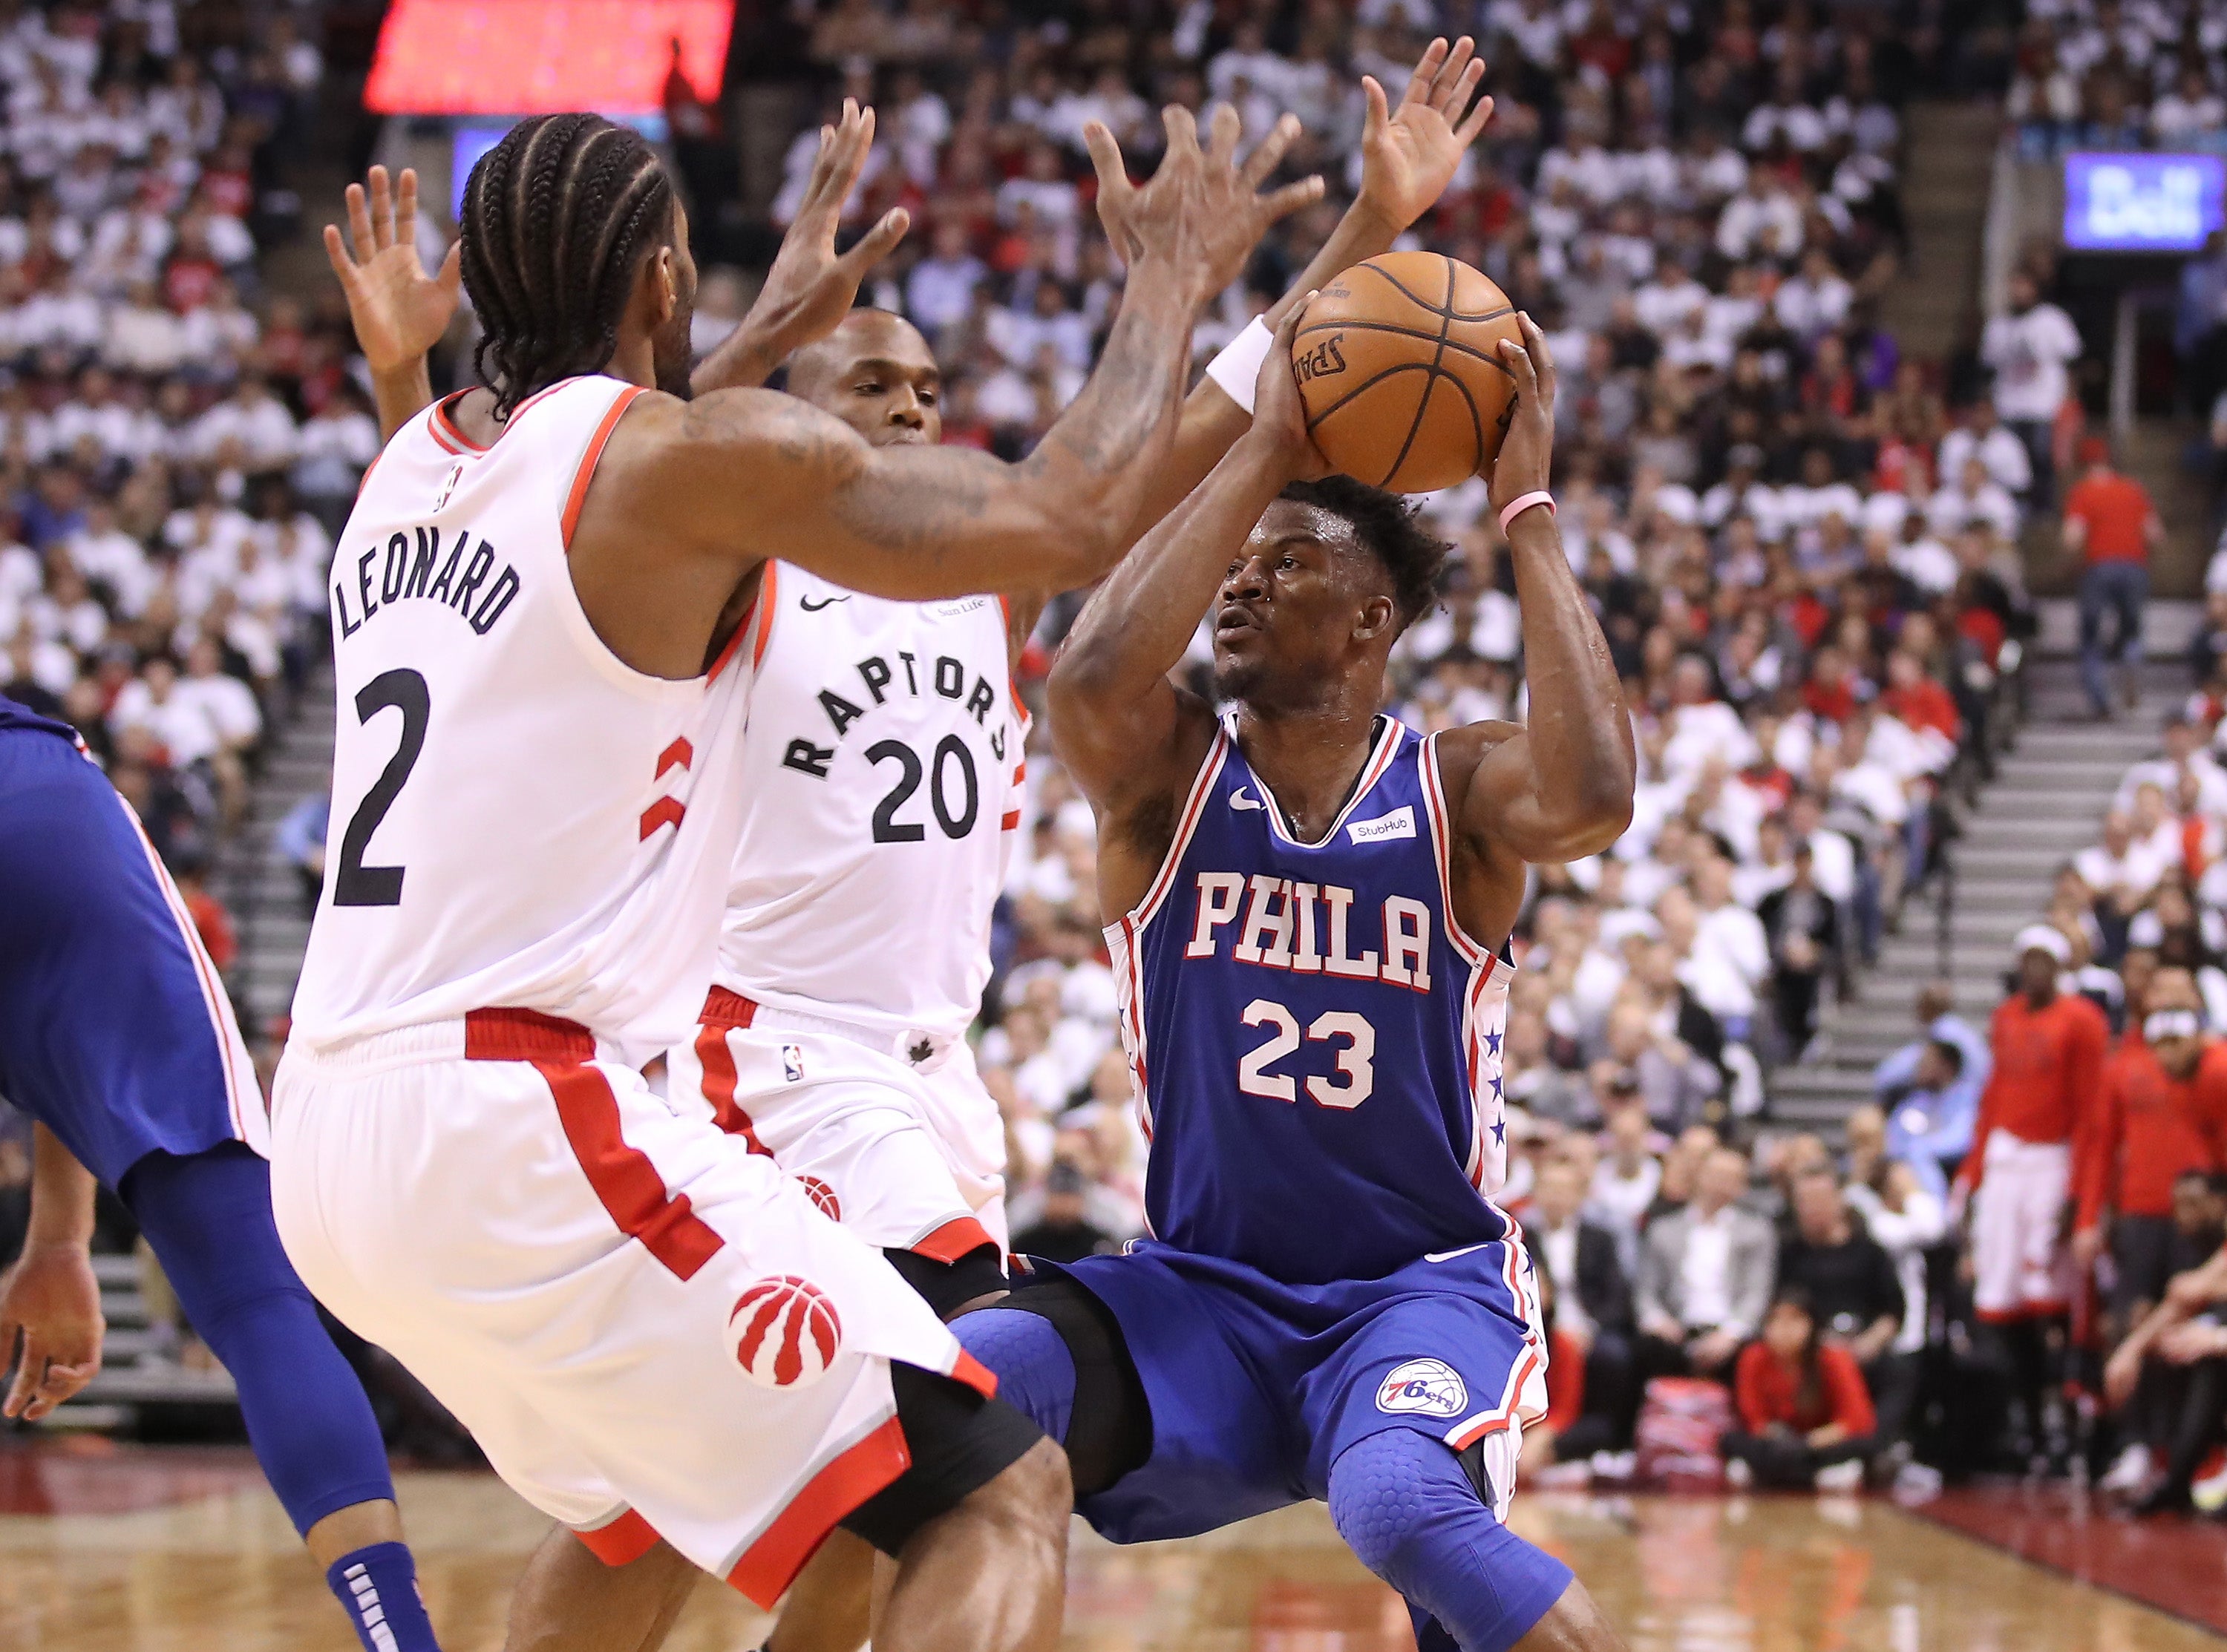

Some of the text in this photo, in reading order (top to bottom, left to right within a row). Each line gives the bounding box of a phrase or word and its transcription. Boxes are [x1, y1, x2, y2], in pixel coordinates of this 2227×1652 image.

[334, 526, 520, 641] LEONARD
[938, 598, 986, 617] Sun Life
[333, 667, 431, 906] 2
[864, 733, 978, 844] 20
[1358, 818, 1407, 836] StubHub
[1184, 871, 1432, 994] PHILA
[1238, 998, 1376, 1110] 23
[1384, 1380, 1454, 1410] 76ers
